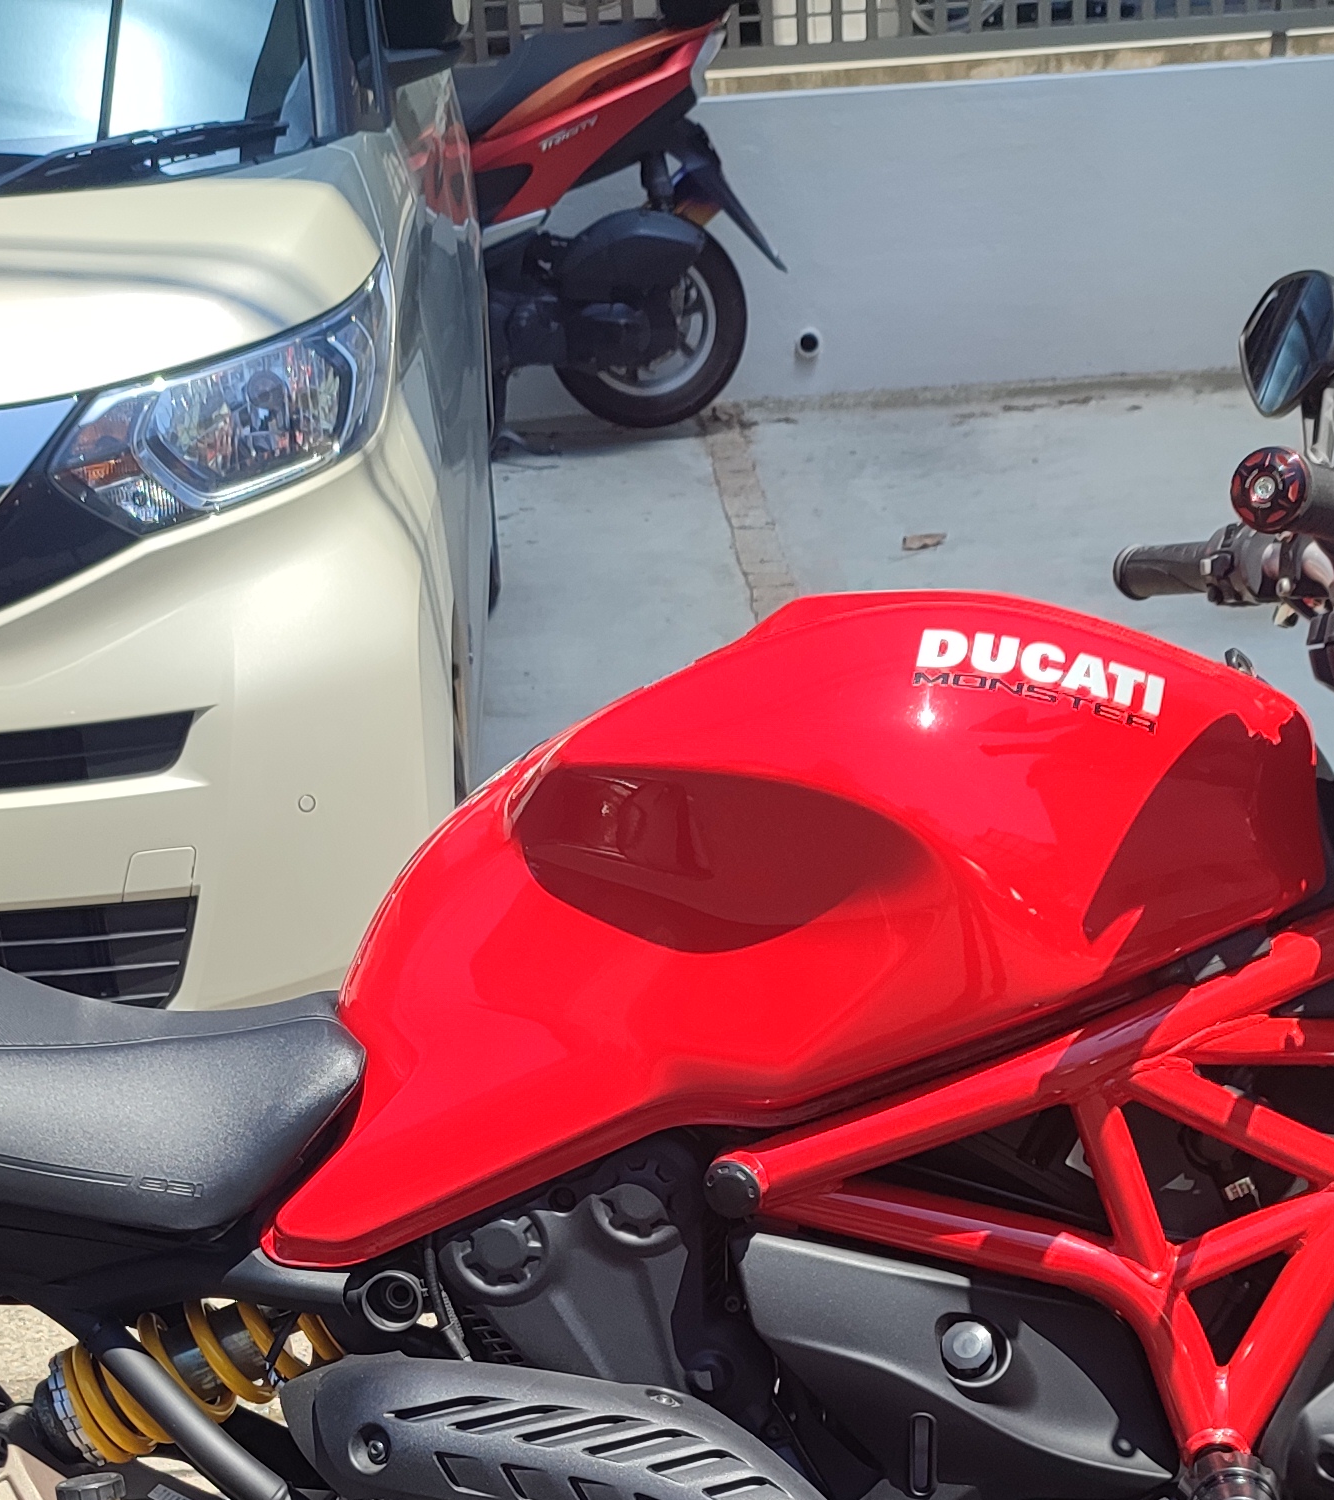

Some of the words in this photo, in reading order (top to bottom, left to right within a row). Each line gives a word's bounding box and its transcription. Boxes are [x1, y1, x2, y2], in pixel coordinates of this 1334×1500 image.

[912, 671, 1158, 735] MONSTER
[915, 628, 1166, 718] DUCATI
[138, 1176, 205, 1199] 821
